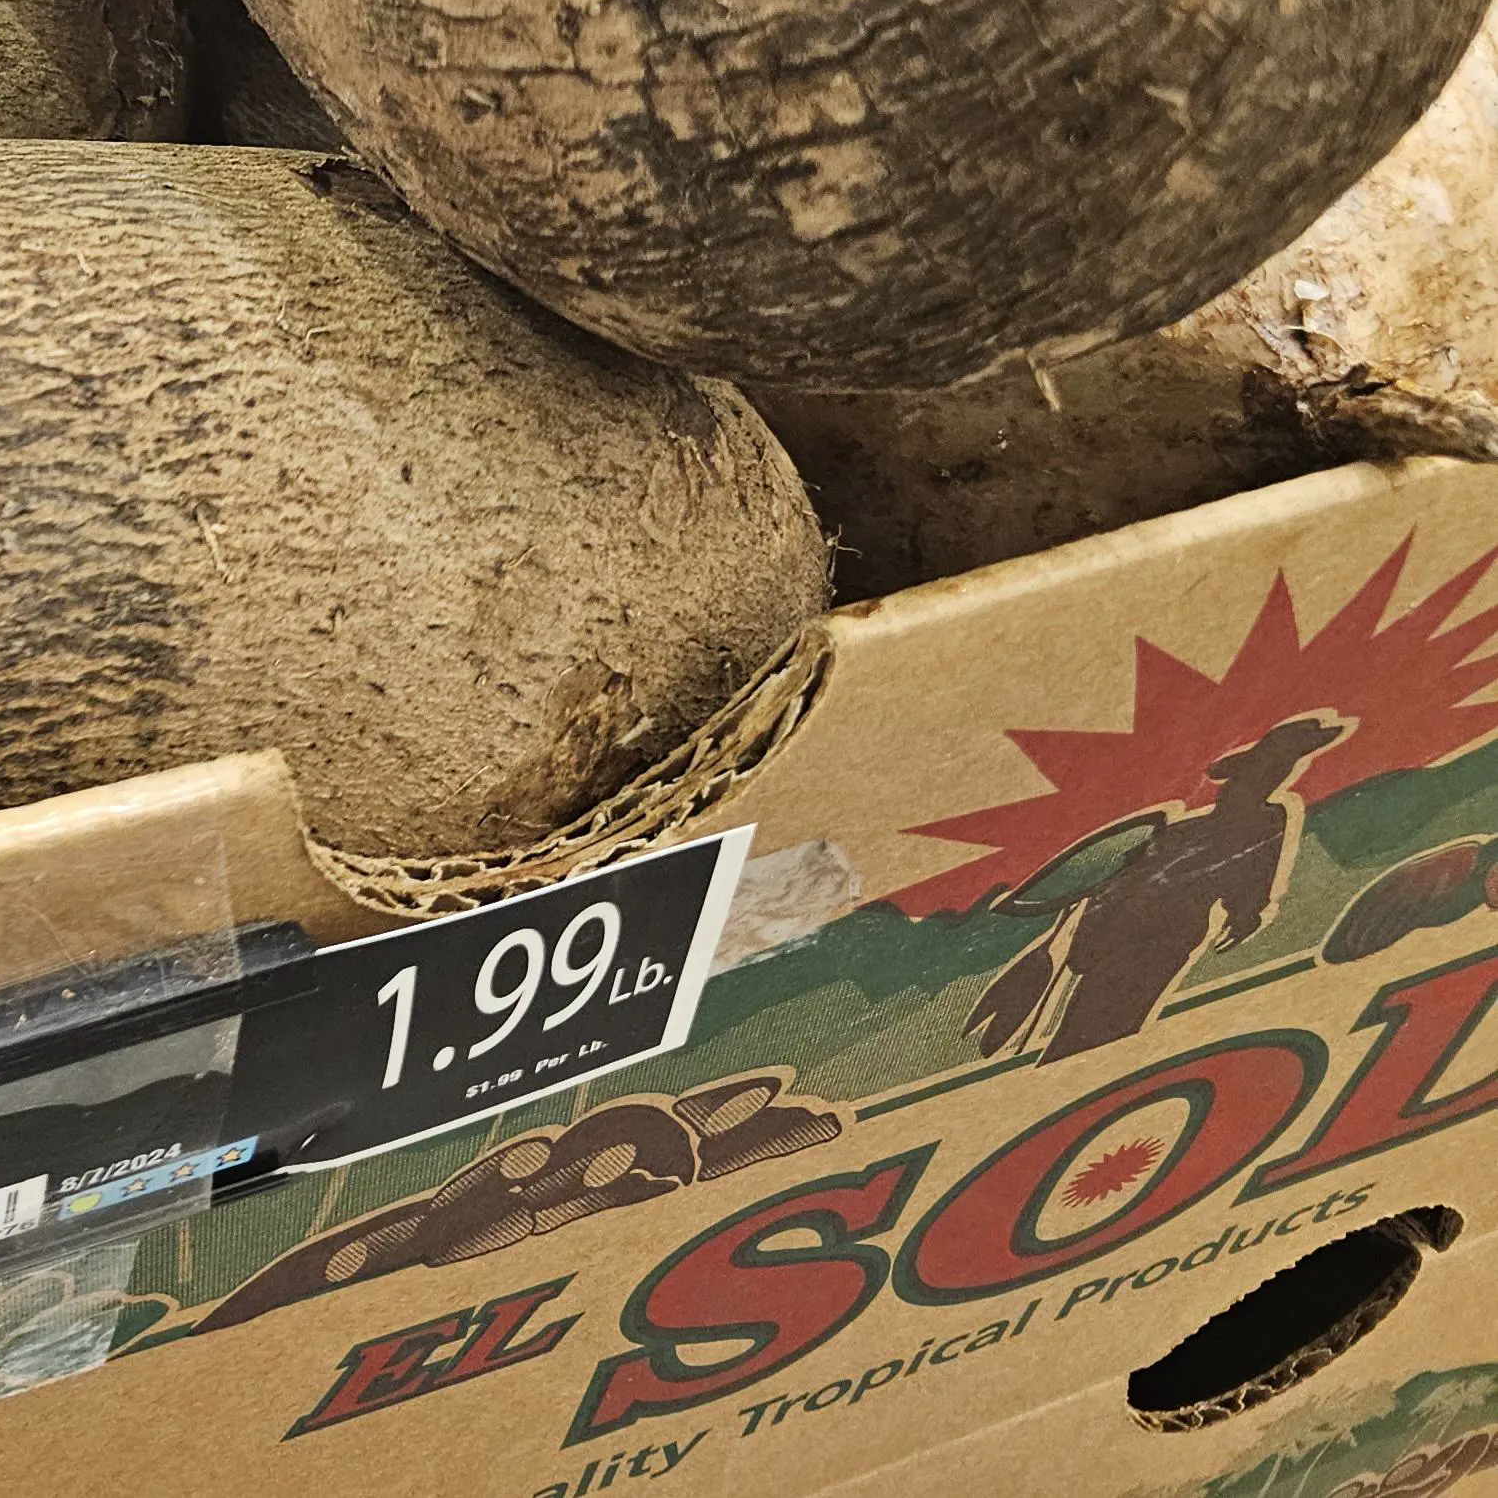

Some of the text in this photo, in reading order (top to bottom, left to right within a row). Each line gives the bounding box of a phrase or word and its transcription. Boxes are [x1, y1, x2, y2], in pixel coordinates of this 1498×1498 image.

[376, 901, 675, 1091] 1.99 Lb.
[534, 1053, 572, 1074] Per
[577, 1039, 610, 1059] Lb.
[60, 1142, 183, 1194] 8/7/2024
[279, 944, 1498, 1451] EL SOL
[738, 1297, 1043, 1439] Tropical
[1054, 1181, 1378, 1322] Products
